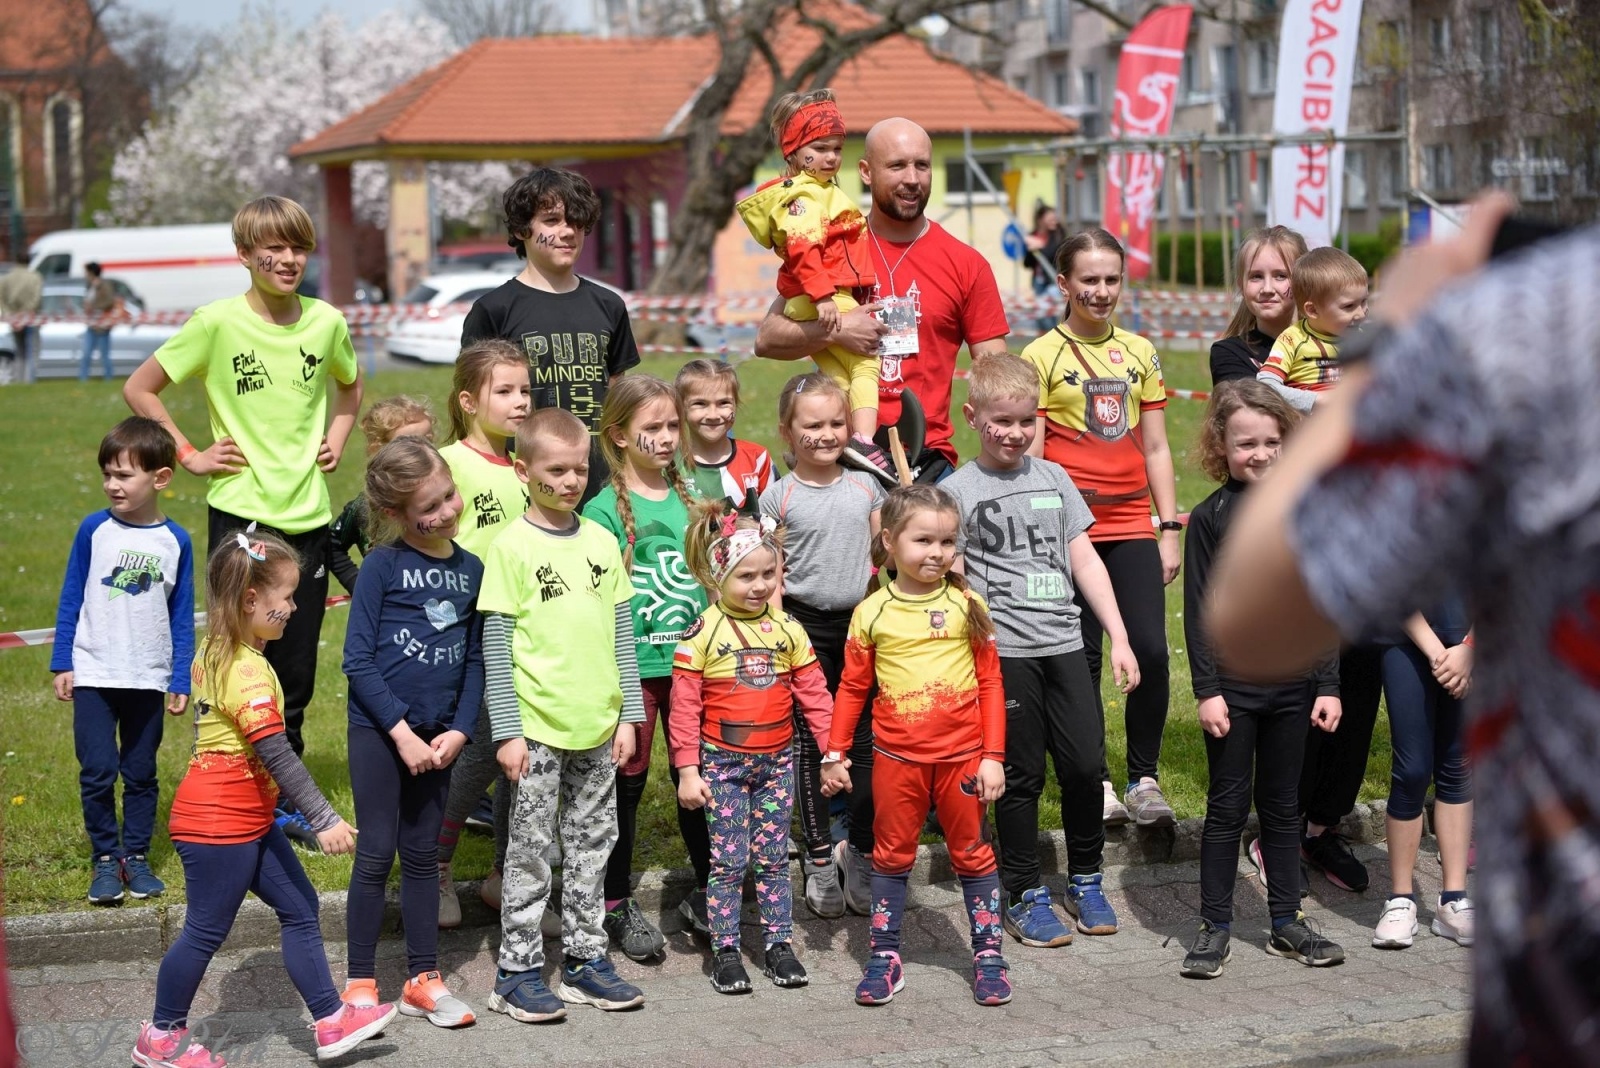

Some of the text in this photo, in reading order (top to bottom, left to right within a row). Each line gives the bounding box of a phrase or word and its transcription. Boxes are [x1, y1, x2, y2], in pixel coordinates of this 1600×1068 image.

[536, 232, 556, 249] 142
[257, 256, 274, 272] 149
[1103, 426, 1118, 436] OCR
[636, 432, 655, 454] 141
[402, 568, 470, 594] MORE
[1033, 575, 1063, 596] PER
[652, 633, 681, 642] FINIS
[930, 630, 948, 639] ALA
[804, 772, 812, 789] BEST
